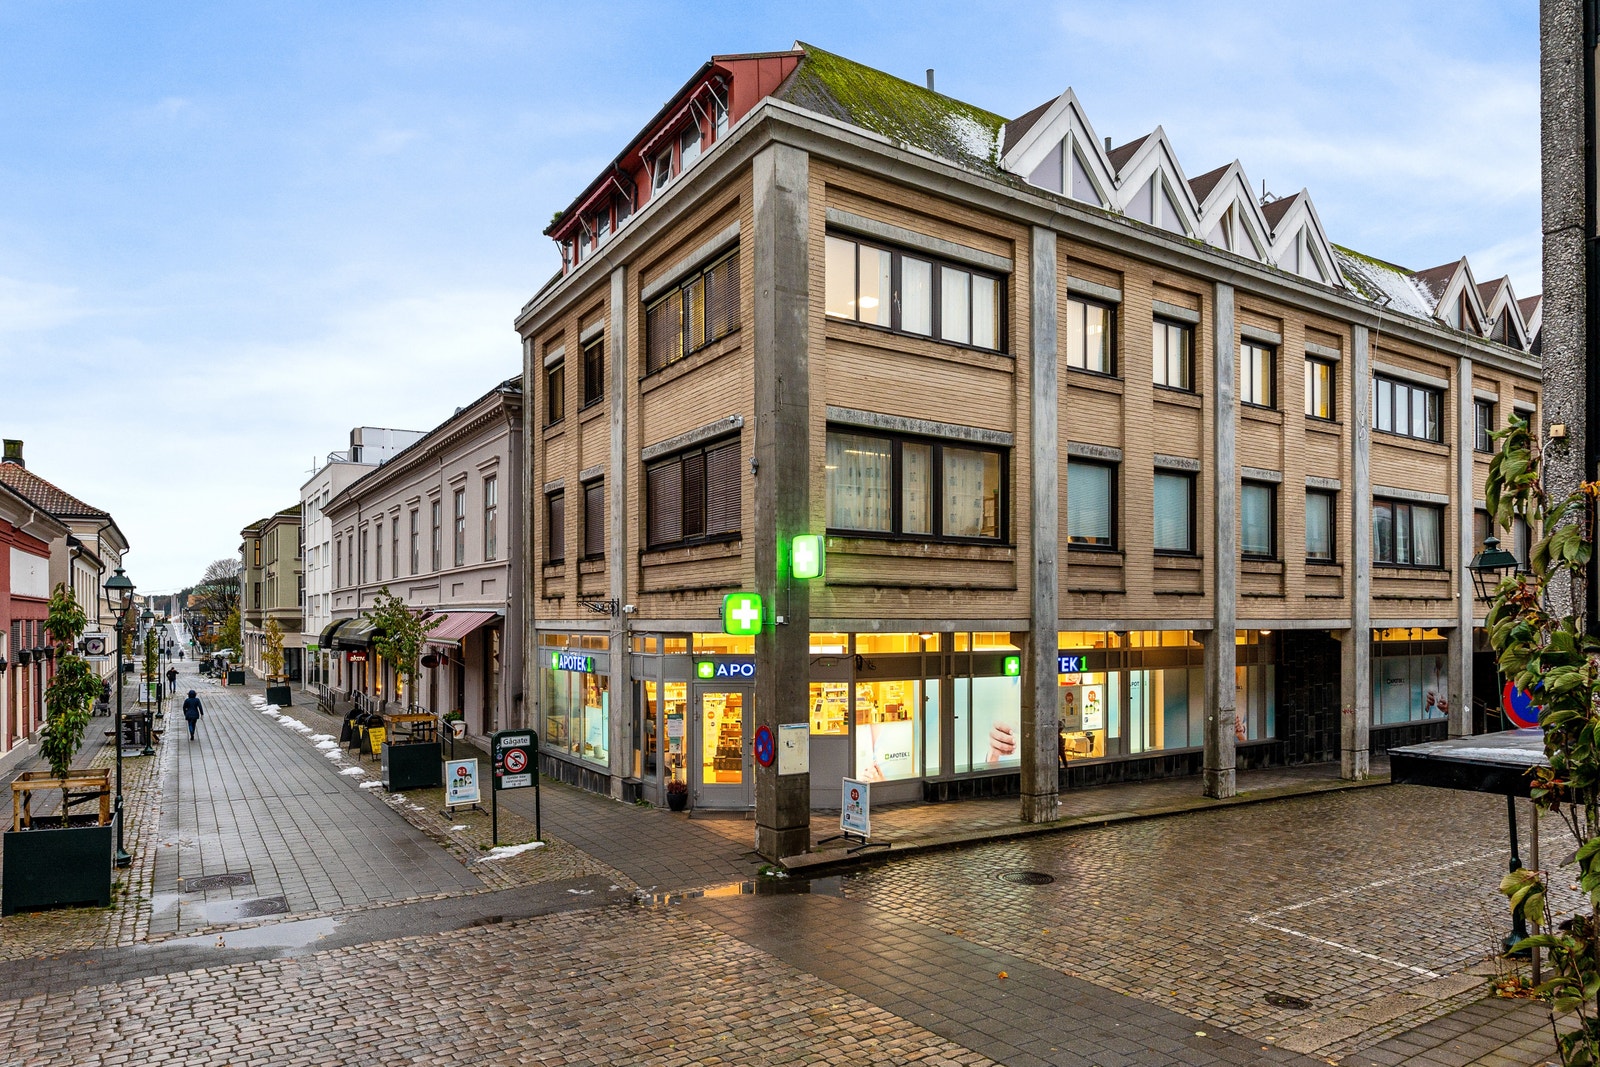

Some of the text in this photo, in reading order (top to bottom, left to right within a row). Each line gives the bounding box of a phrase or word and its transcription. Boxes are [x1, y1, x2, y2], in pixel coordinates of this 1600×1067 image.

[559, 655, 592, 672] APOTEK 1
[716, 663, 755, 676] APO
[1079, 655, 1088, 671] 1
